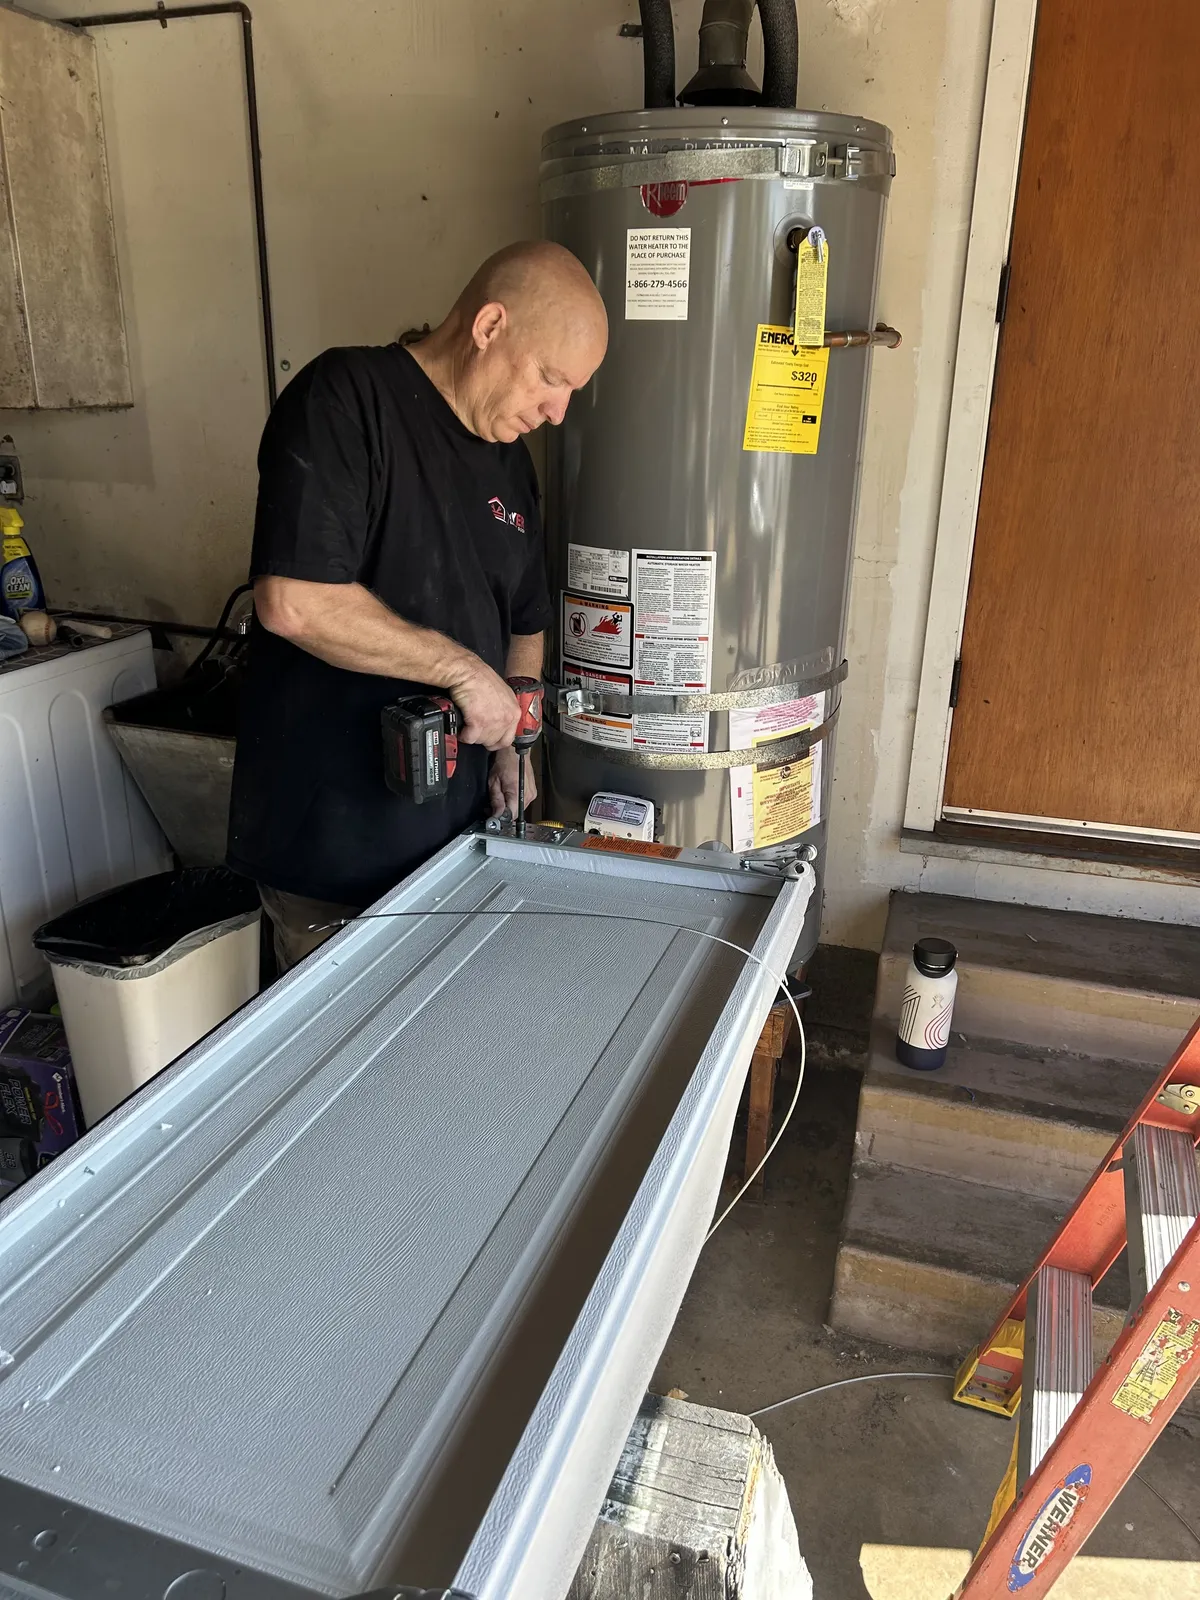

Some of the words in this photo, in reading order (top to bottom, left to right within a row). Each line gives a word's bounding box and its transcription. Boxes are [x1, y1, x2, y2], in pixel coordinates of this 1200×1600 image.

[627, 279, 688, 288] 1-866-279-4566
[760, 331, 795, 346] ENERG
[791, 371, 818, 382] $320
[10, 576, 25, 585] OXI
[6, 583, 31, 593] CLEAN
[8, 1078, 32, 1125] POWER
[1022, 1490, 1077, 1569] WERNER
